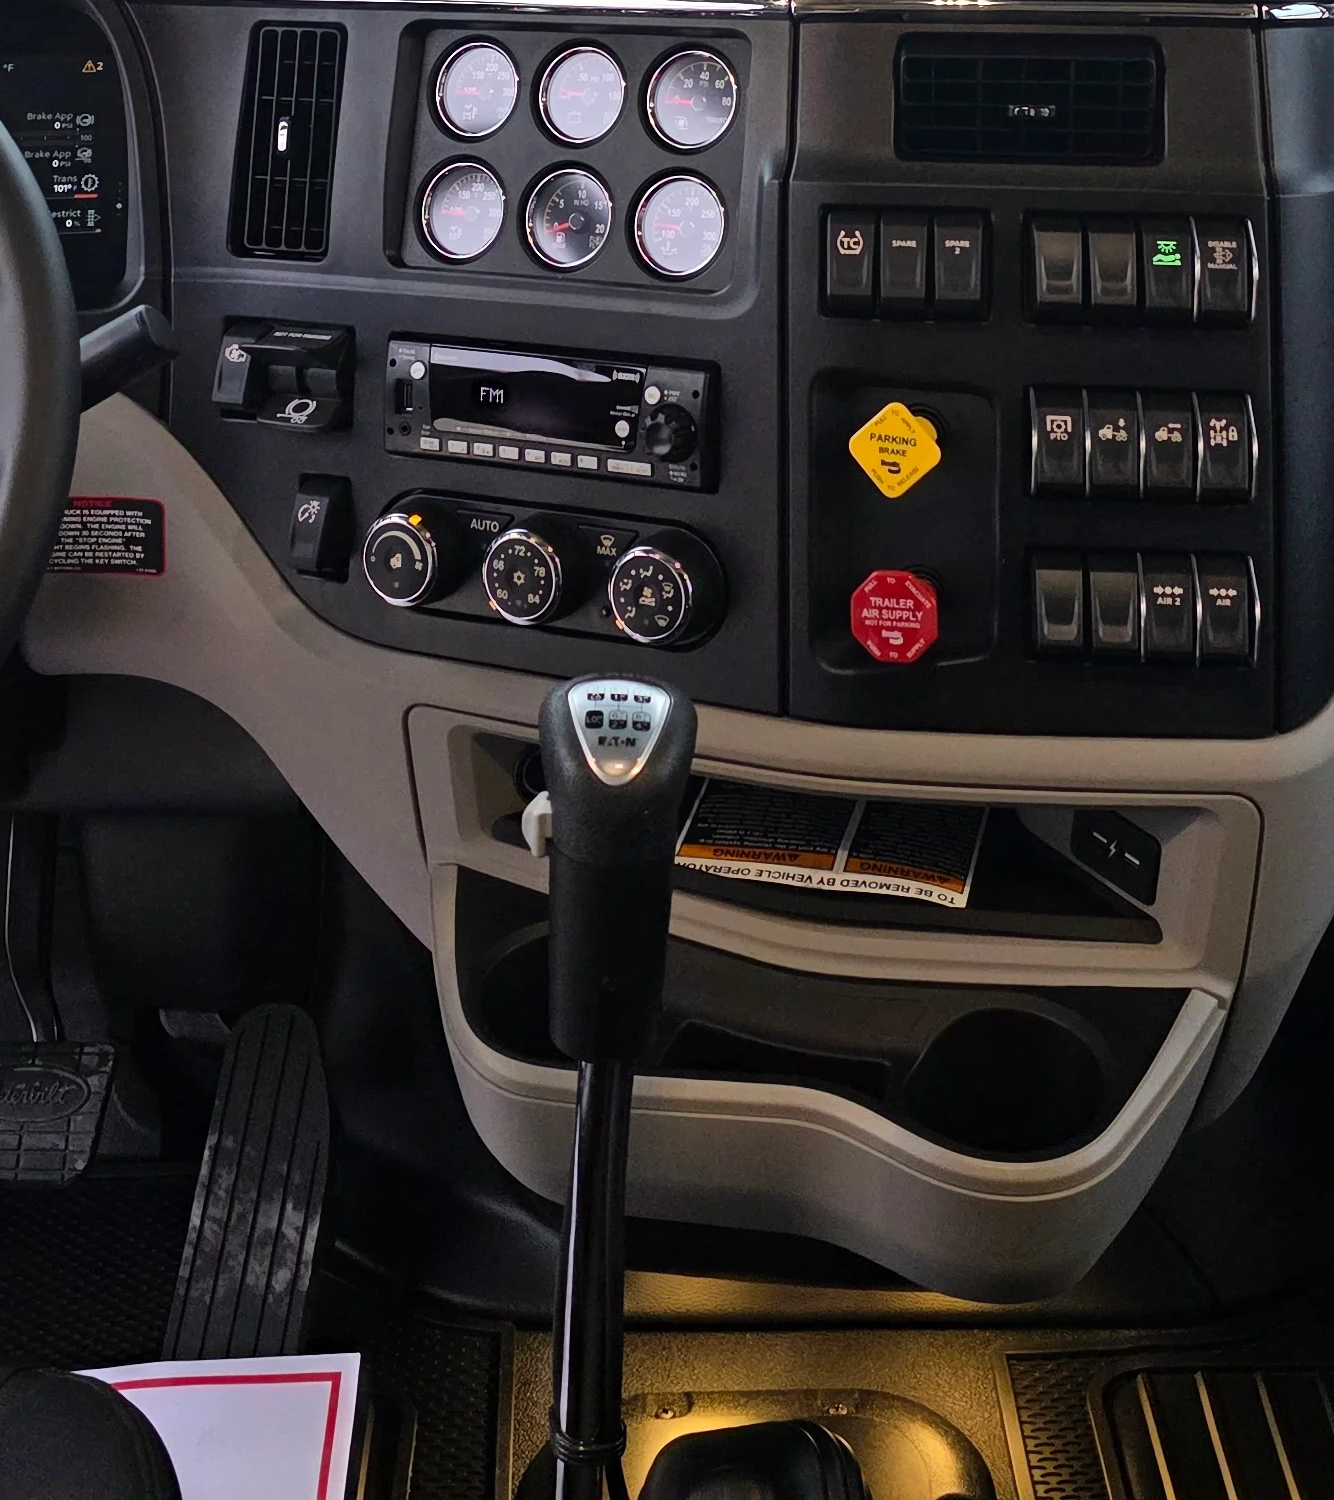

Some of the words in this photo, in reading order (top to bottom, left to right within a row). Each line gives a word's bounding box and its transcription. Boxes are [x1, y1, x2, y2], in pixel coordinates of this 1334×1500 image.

[96, 62, 104, 71] 2
[485, 63, 499, 72] 200
[471, 71, 485, 80] 150
[496, 71, 511, 81] 250
[699, 71, 710, 80] 40
[683, 79, 693, 89] 20
[714, 79, 725, 89] 60
[721, 96, 732, 106] 80
[26, 112, 53, 121] Brake
[54, 112, 74, 123] App
[54, 121, 61, 130] 0
[24, 150, 50, 159] Brake
[52, 150, 72, 161] App
[52, 159, 59, 168] 0
[53, 174, 78, 184] Trans
[577, 190, 587, 199] 10
[558, 199, 565, 209] 5
[594, 200, 605, 210] 15
[685, 197, 700, 206] 200
[667, 208, 681, 218] 150
[700, 209, 716, 219] 250
[595, 224, 605, 234] 20
[661, 229, 675, 239] 100
[841, 237, 859, 249] TC
[891, 239, 917, 248] SPARE
[944, 239, 970, 248] SPARE
[1207, 240, 1237, 249] DISABLE
[1207, 262, 1238, 270] MANUAL
[480, 386, 504, 404] FM1
[870, 432, 917, 447] PARKING
[1050, 433, 1069, 441] PTO
[878, 446, 908, 457] BRAKE
[897, 466, 920, 487] RELEASE
[73, 500, 113, 508] NOTICE
[109, 517, 152, 525] PROTECTION
[470, 518, 500, 533] AUTO
[513, 545, 525, 557] 72
[596, 545, 617, 557] MAX
[492, 559, 505, 571] 66
[533, 566, 546, 578] 78
[496, 588, 508, 600] 60
[864, 579, 878, 594] PULL
[886, 576, 896, 584] TO
[904, 580, 932, 609] EVACUATE
[527, 592, 540, 605] 84
[869, 596, 915, 609] TRAILER
[1156, 597, 1173, 606] AIR
[1174, 597, 1181, 606] 2
[1215, 598, 1231, 607] AIR
[861, 608, 880, 619] AIR
[881, 609, 923, 621] SUPPLY
[892, 621, 921, 629] PARKING
[866, 639, 882, 657] PUSH
[889, 651, 899, 659] TO
[905, 637, 926, 659] SUPPLY
[712, 848, 785, 861] WARNING
[859, 860, 940, 882] WARNING
[754, 868, 814, 885] VEHICLE
[817, 877, 835, 887] BY
[839, 878, 911, 894] REMOVED
[914, 888, 933, 897] BE
[937, 893, 955, 905] TO
